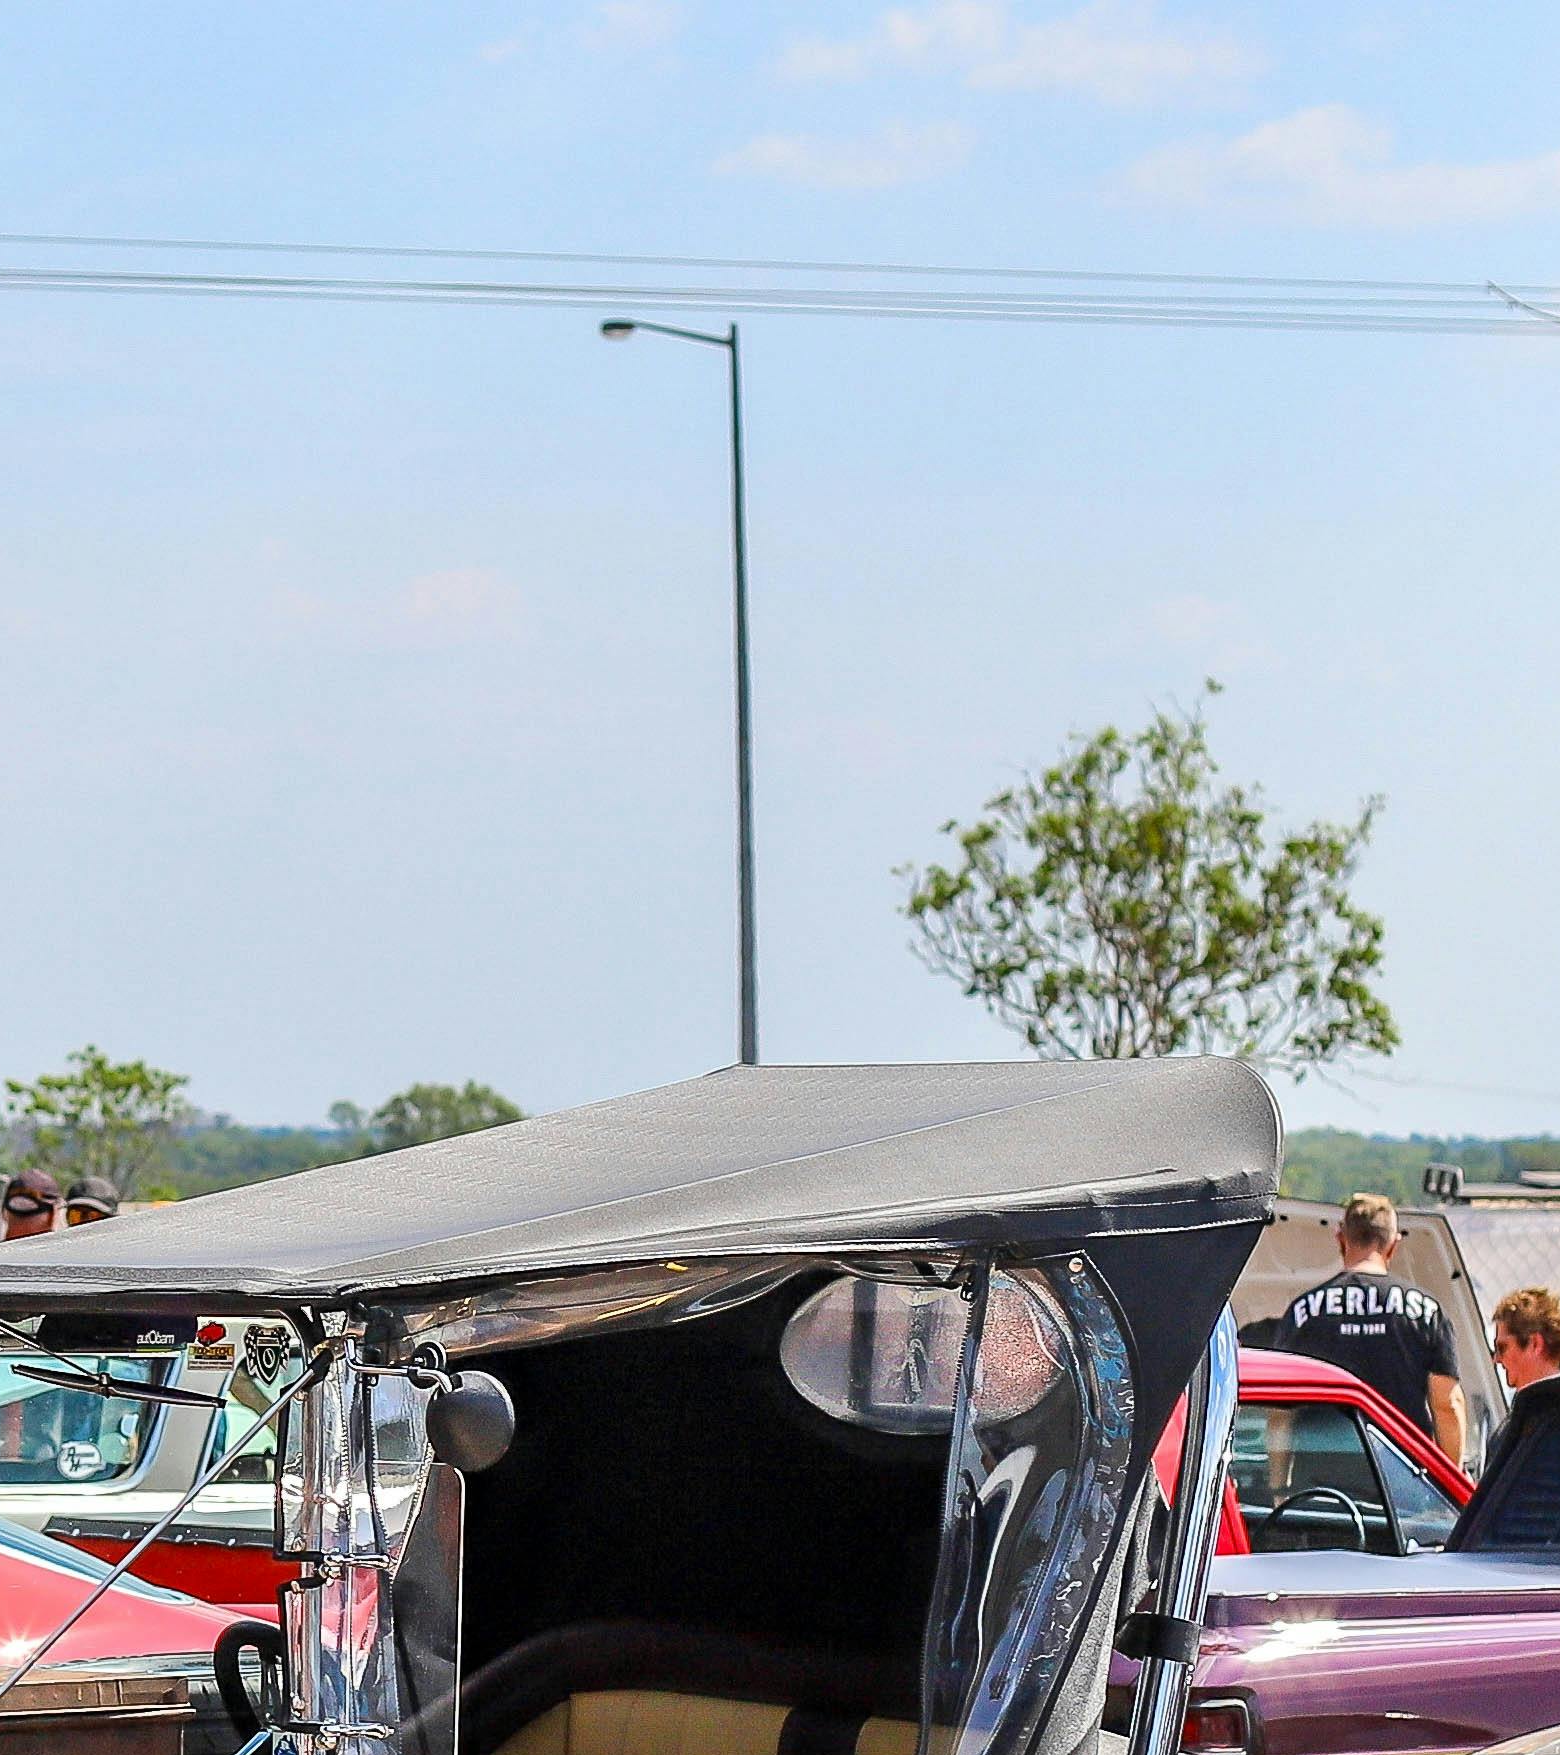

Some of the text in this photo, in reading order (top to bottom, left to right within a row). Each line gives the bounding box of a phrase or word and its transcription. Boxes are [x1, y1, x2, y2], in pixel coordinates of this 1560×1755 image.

[1293, 1285, 1439, 1328] EVERLAST
[1340, 1323, 1386, 1336] NEW YORK
